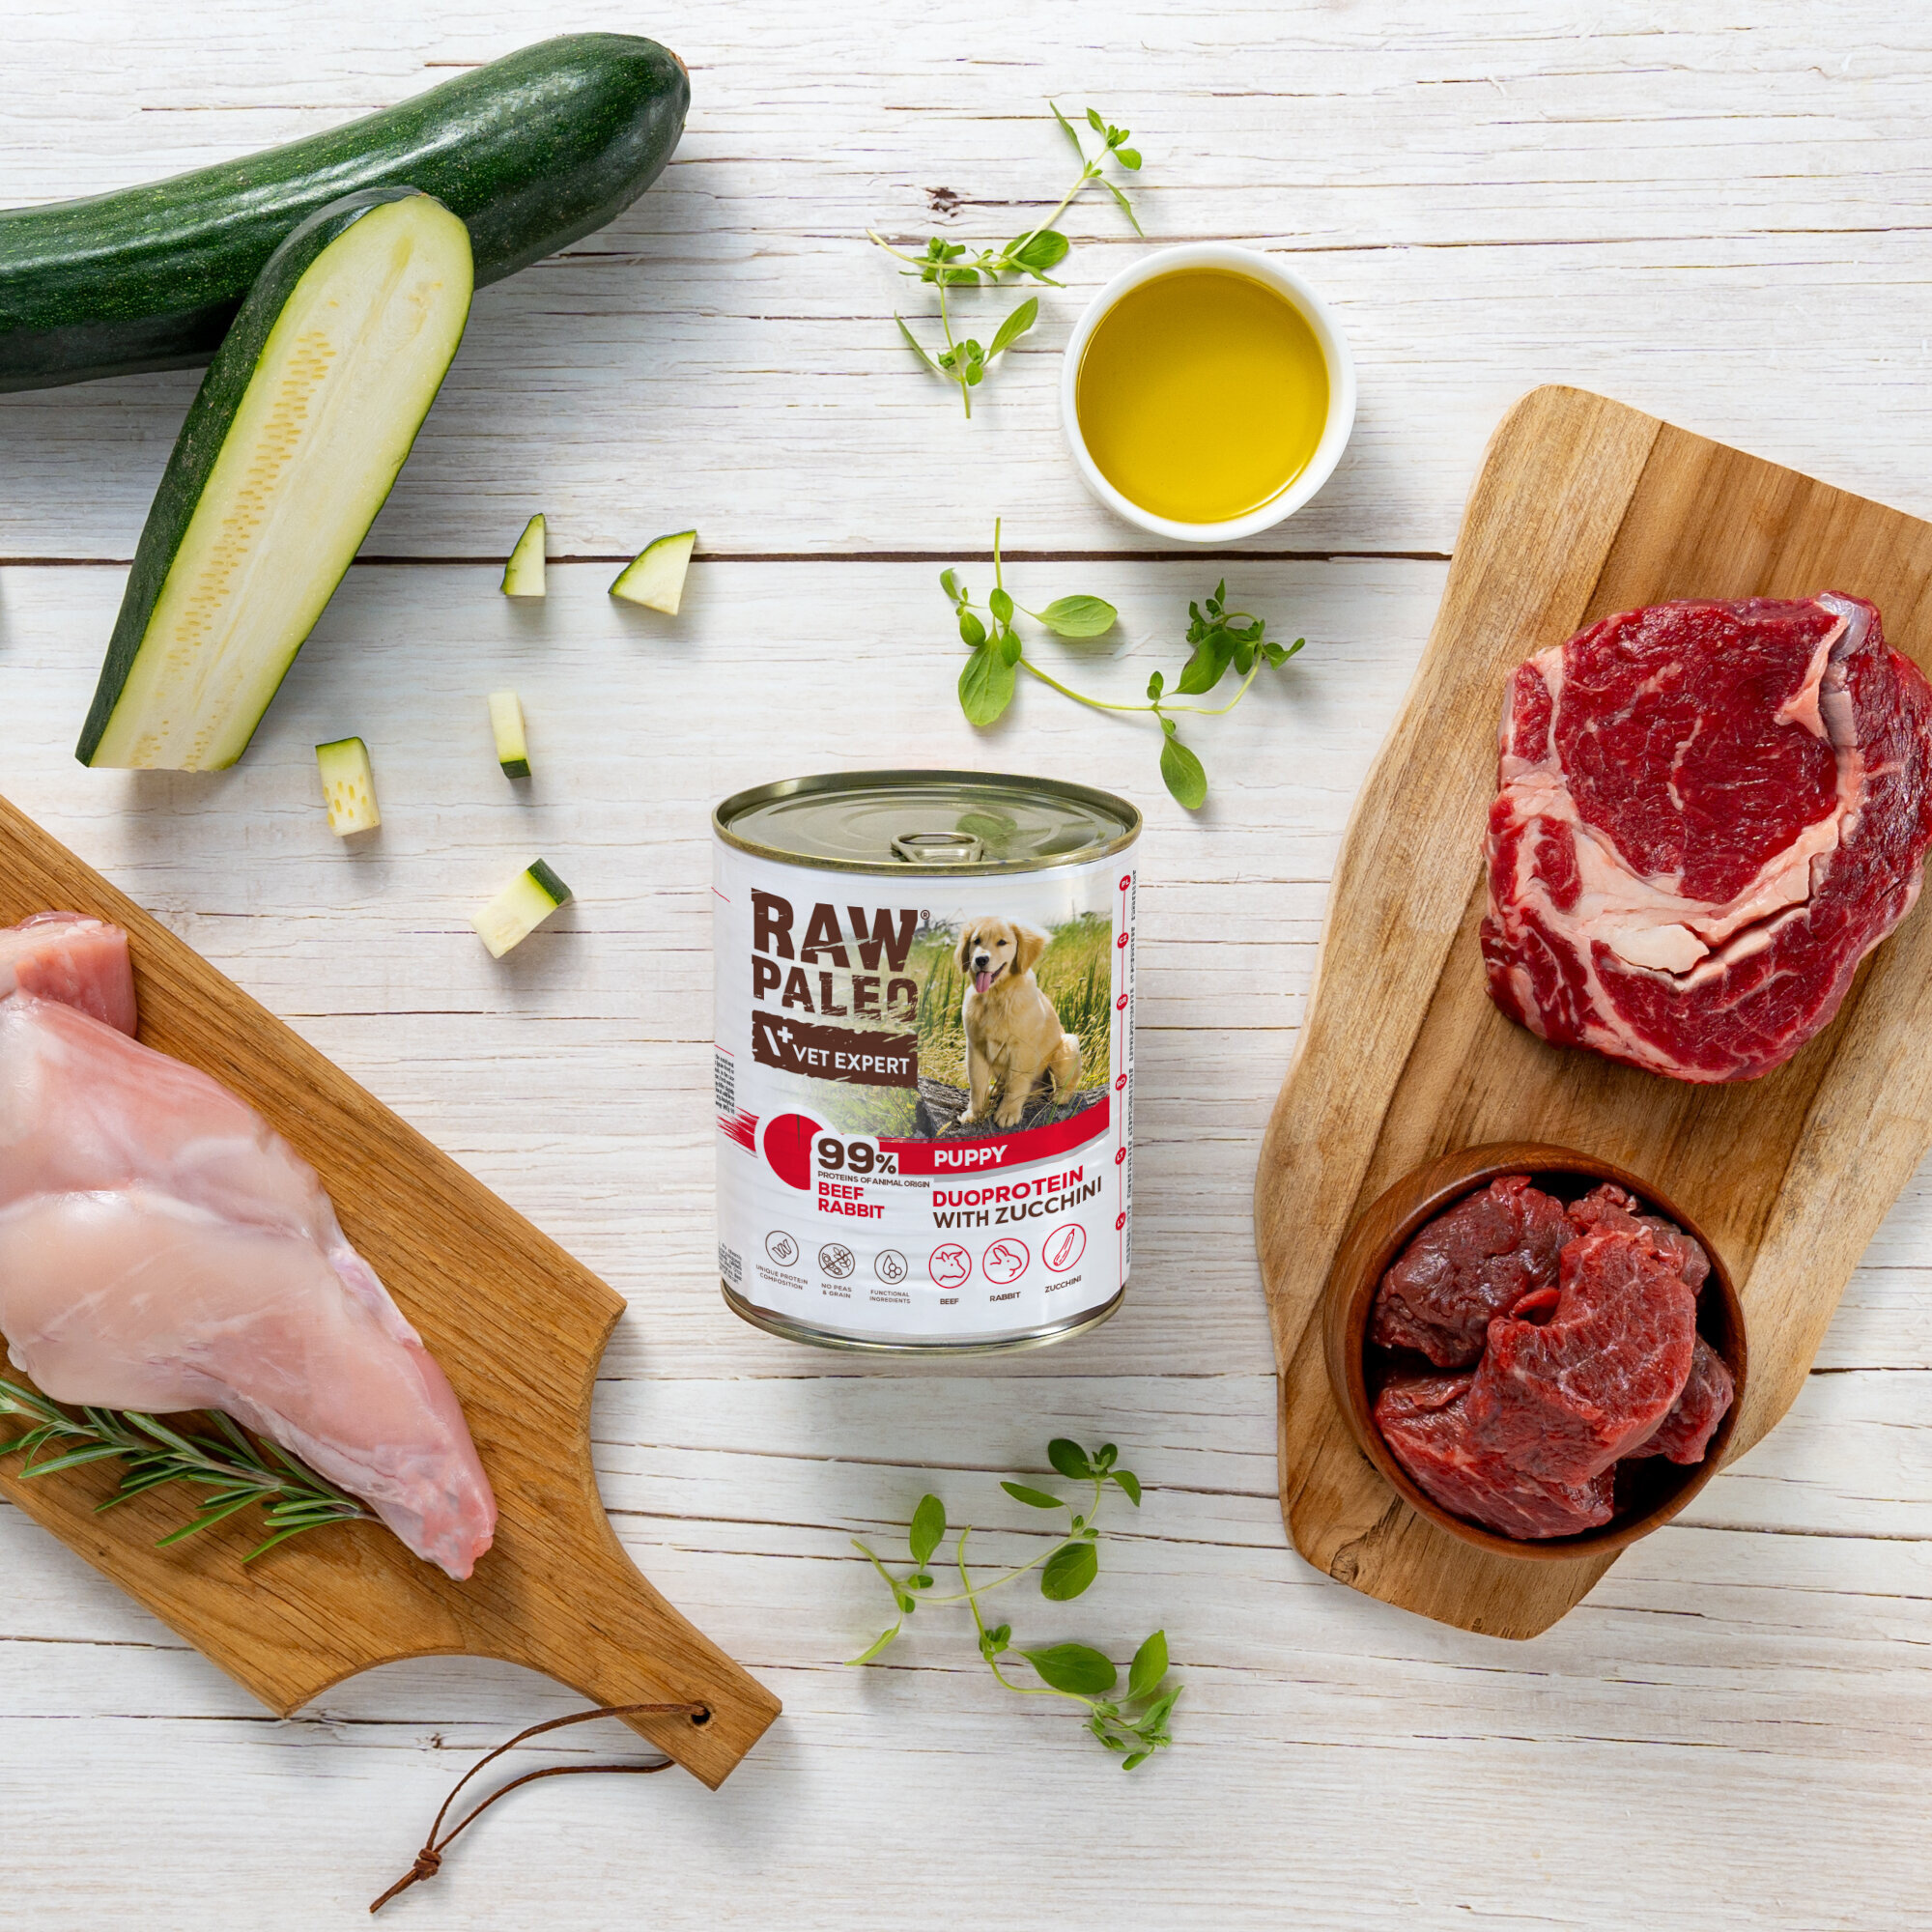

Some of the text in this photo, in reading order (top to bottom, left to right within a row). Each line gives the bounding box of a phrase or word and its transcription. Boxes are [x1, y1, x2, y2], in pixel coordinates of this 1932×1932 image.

[751, 887, 919, 973] RAW
[751, 953, 919, 1022] PALEO
[793, 1043, 910, 1075] VET EXPERT
[817, 1137, 896, 1175] 99%
[934, 1145, 1009, 1168] PUPPY
[817, 1170, 859, 1183] PROTEINS
[860, 1177, 872, 1185] OF
[872, 1178, 903, 1188] ANIMAL
[932, 1164, 1084, 1208] DUOPROTEIN
[818, 1180, 865, 1201] BEEF
[818, 1197, 886, 1220] RABBIT
[932, 1175, 1102, 1229] WITH ZUCCHINI
[755, 1264, 809, 1285] UNIQUE PROTEIN
[759, 1272, 804, 1291] COMPOSITION
[1044, 1274, 1082, 1293] ZUCCHINI
[828, 1290, 851, 1299] GRAIN
[833, 1284, 852, 1293] PEAS
[869, 1289, 910, 1297] FUNCTIONAL
[989, 1291, 1021, 1302] RABBIT
[869, 1295, 911, 1304] INGREDIENTS
